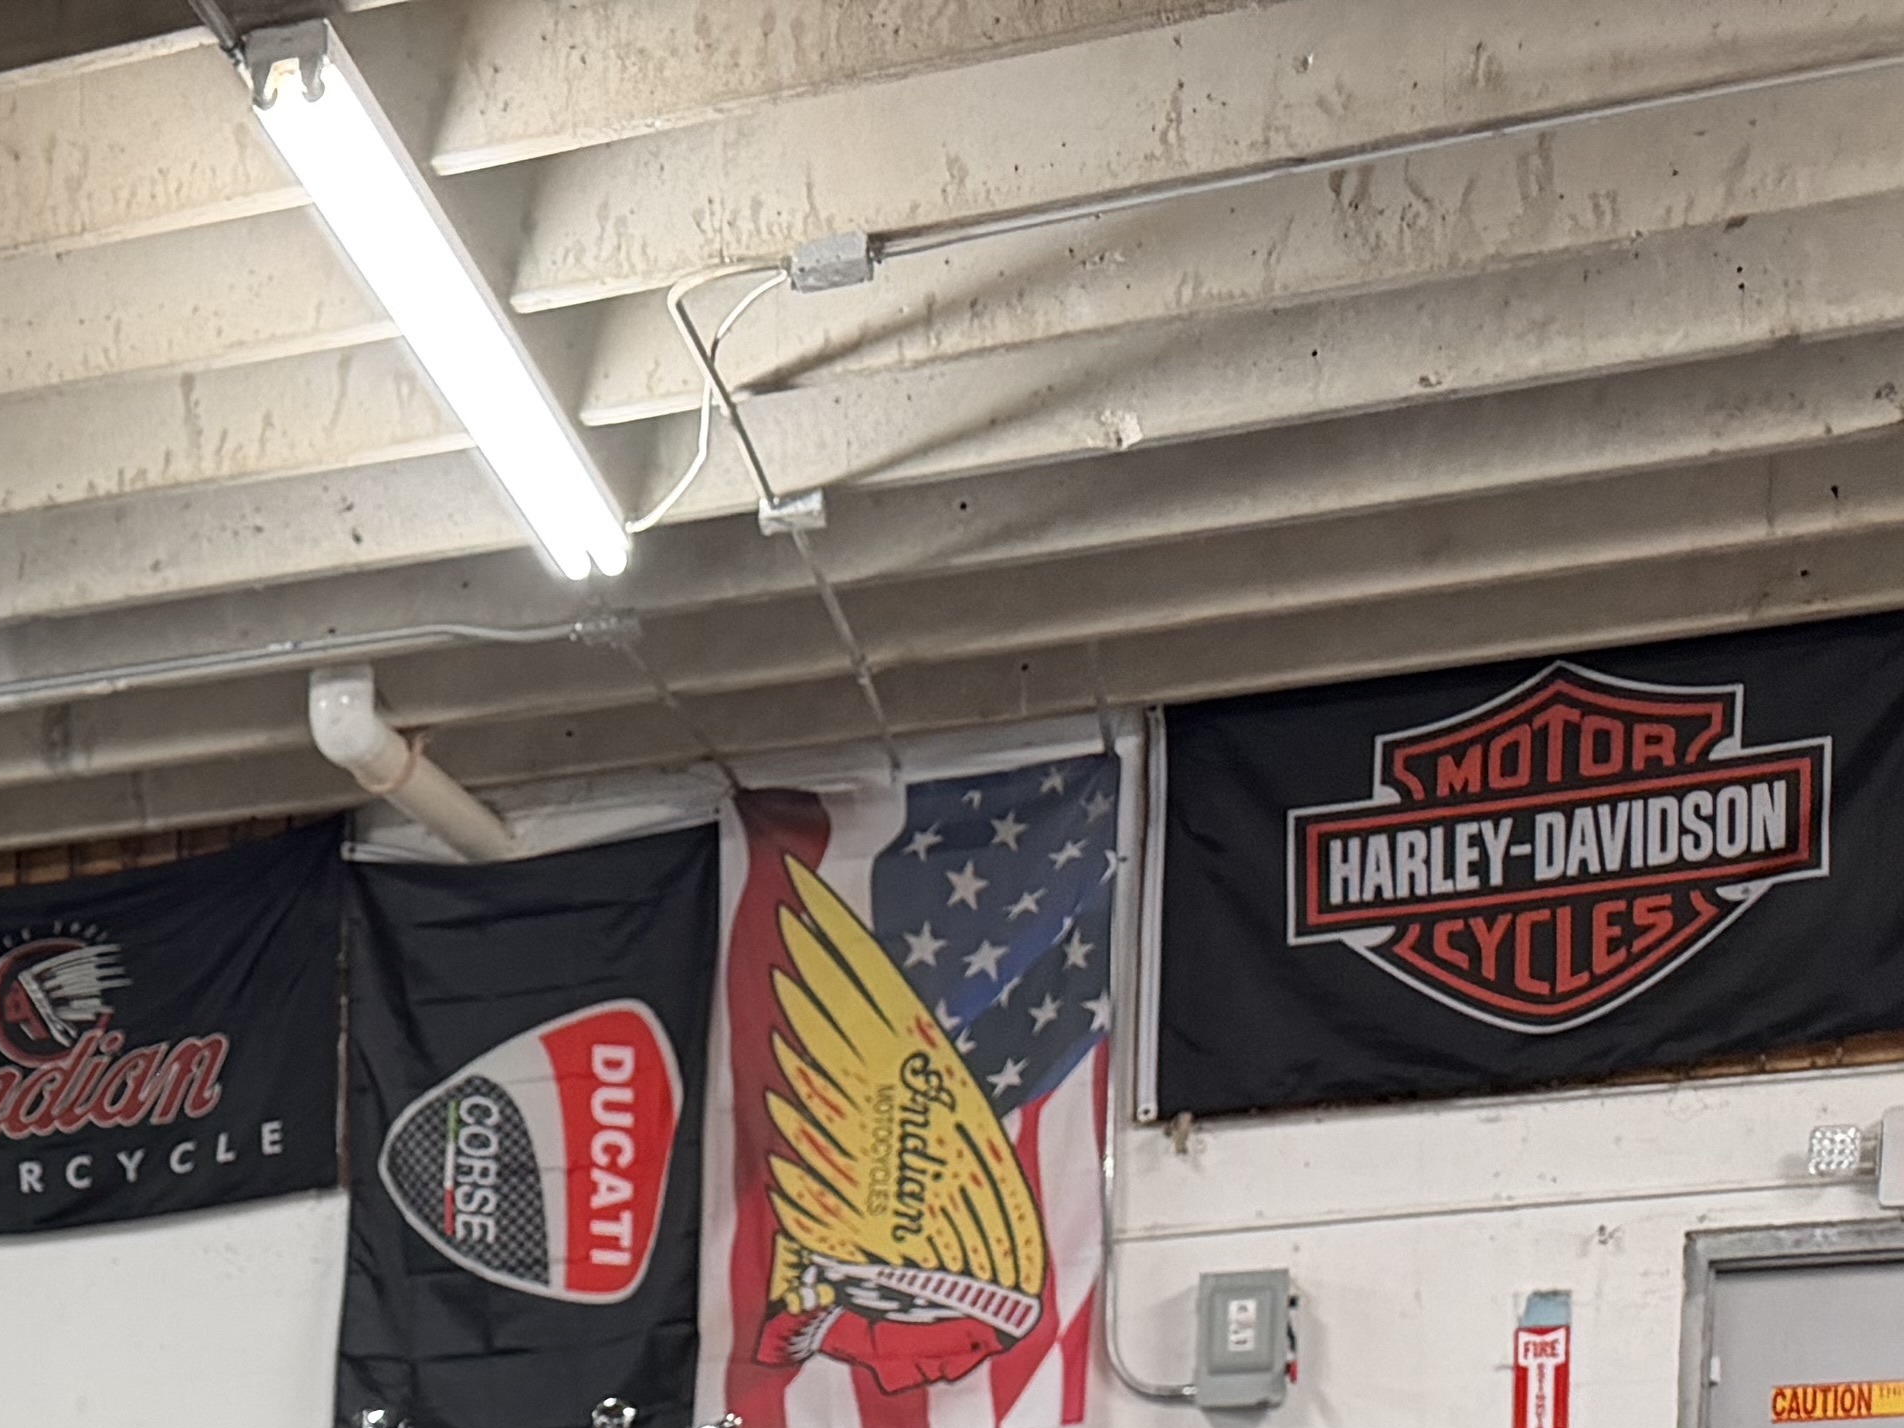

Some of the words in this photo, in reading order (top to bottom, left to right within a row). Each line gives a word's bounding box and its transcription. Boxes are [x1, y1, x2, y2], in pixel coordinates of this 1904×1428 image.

[1436, 703, 1676, 798] MOTOR
[1328, 779, 1787, 905] HARLEY-DAVIDSON
[1432, 895, 1673, 996] CYCLES
[455, 1095, 499, 1244] CORSE
[589, 1044, 635, 1266] DUCATI
[891, 1051, 956, 1243] Indian
[1523, 1338, 1560, 1360] FIRE
[1772, 1384, 1873, 1418] CAUTION
